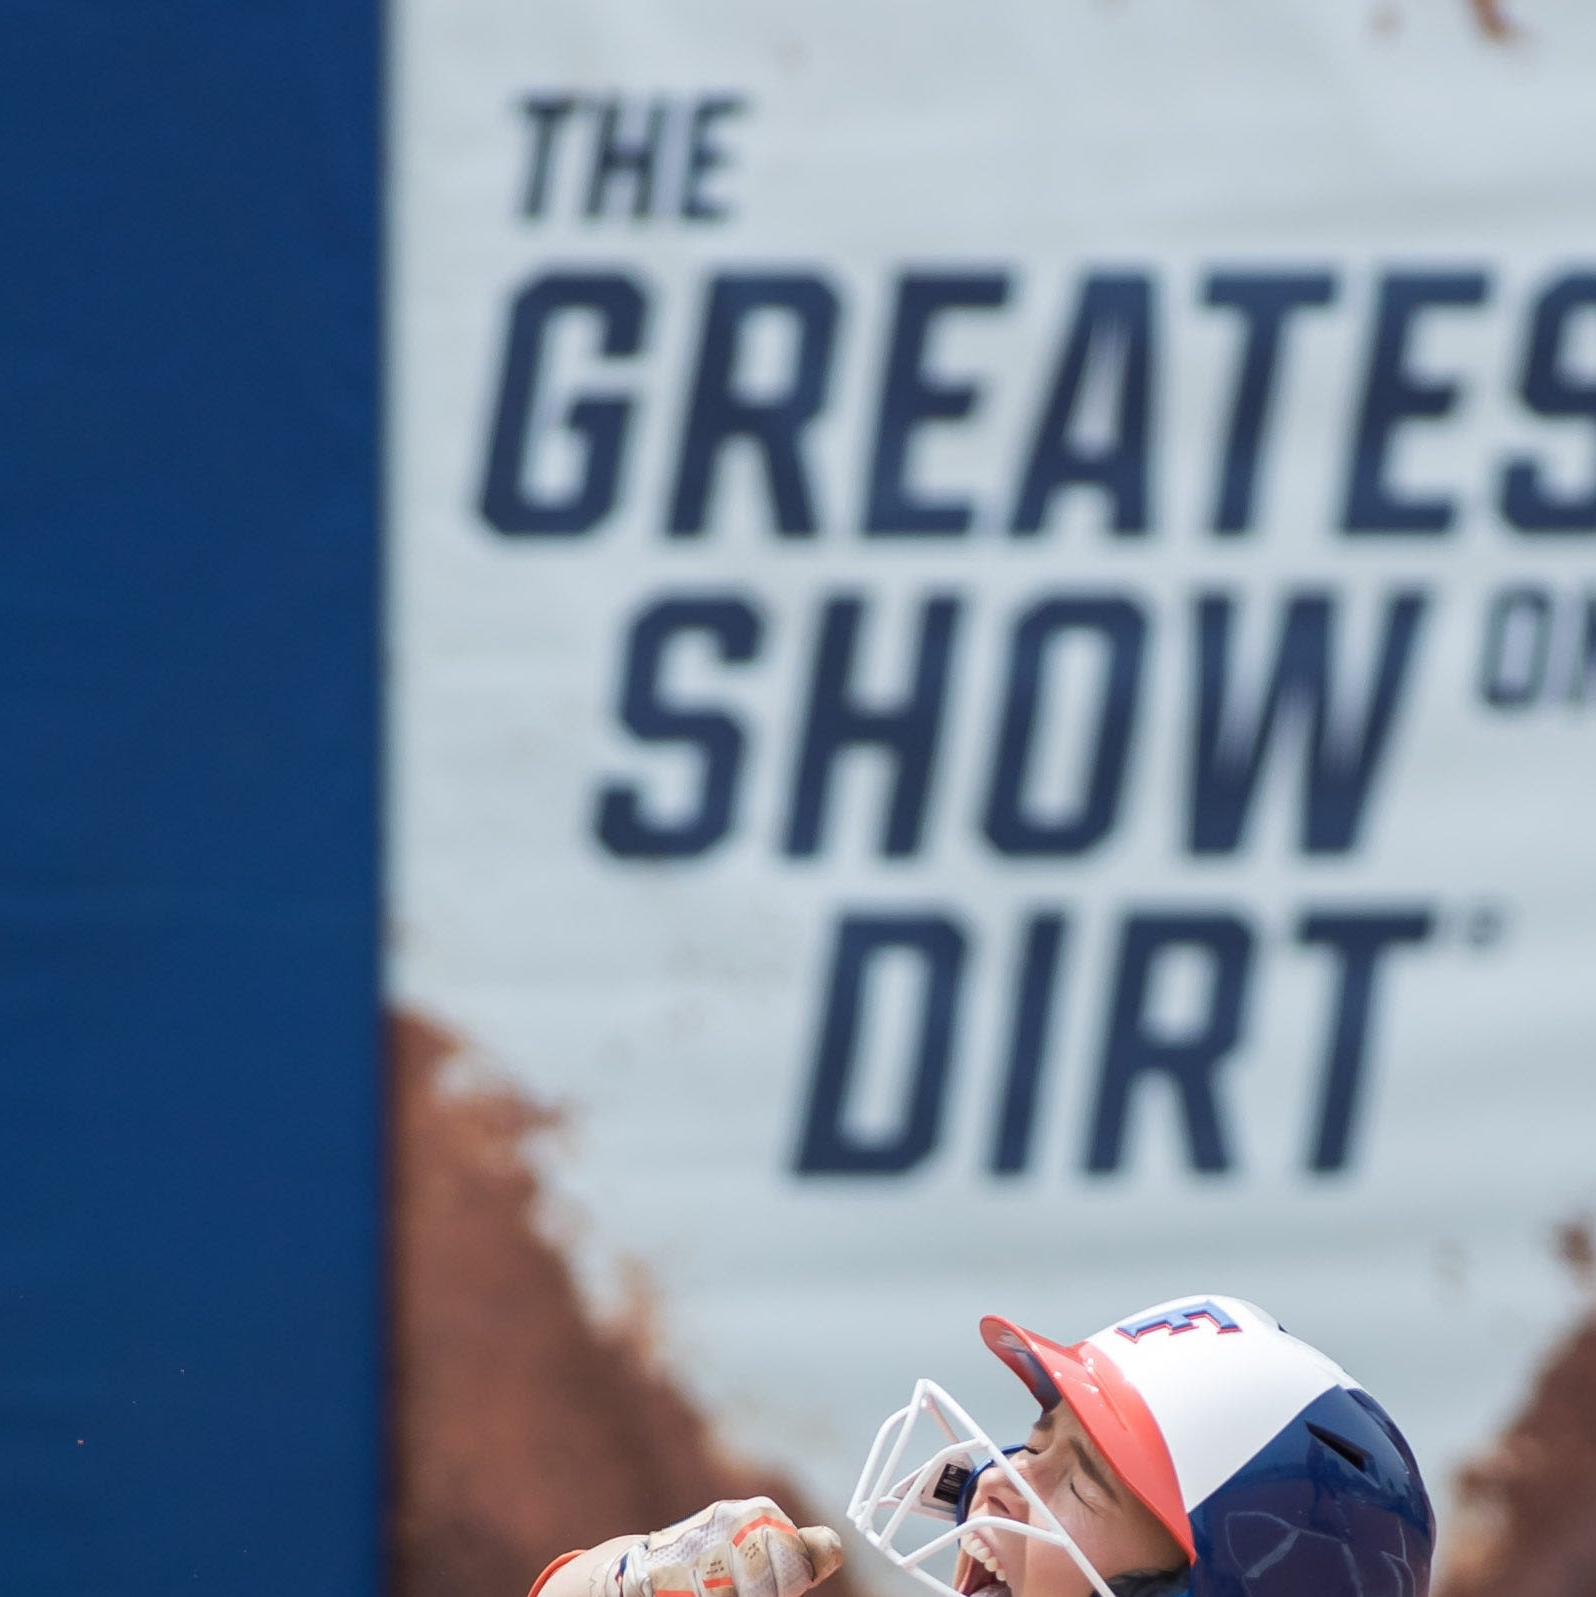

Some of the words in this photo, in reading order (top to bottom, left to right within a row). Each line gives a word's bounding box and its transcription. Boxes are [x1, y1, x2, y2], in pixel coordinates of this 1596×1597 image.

[519, 93, 745, 224] THE
[590, 588, 1429, 862] SHOW
[789, 906, 1437, 1181] DIRT
